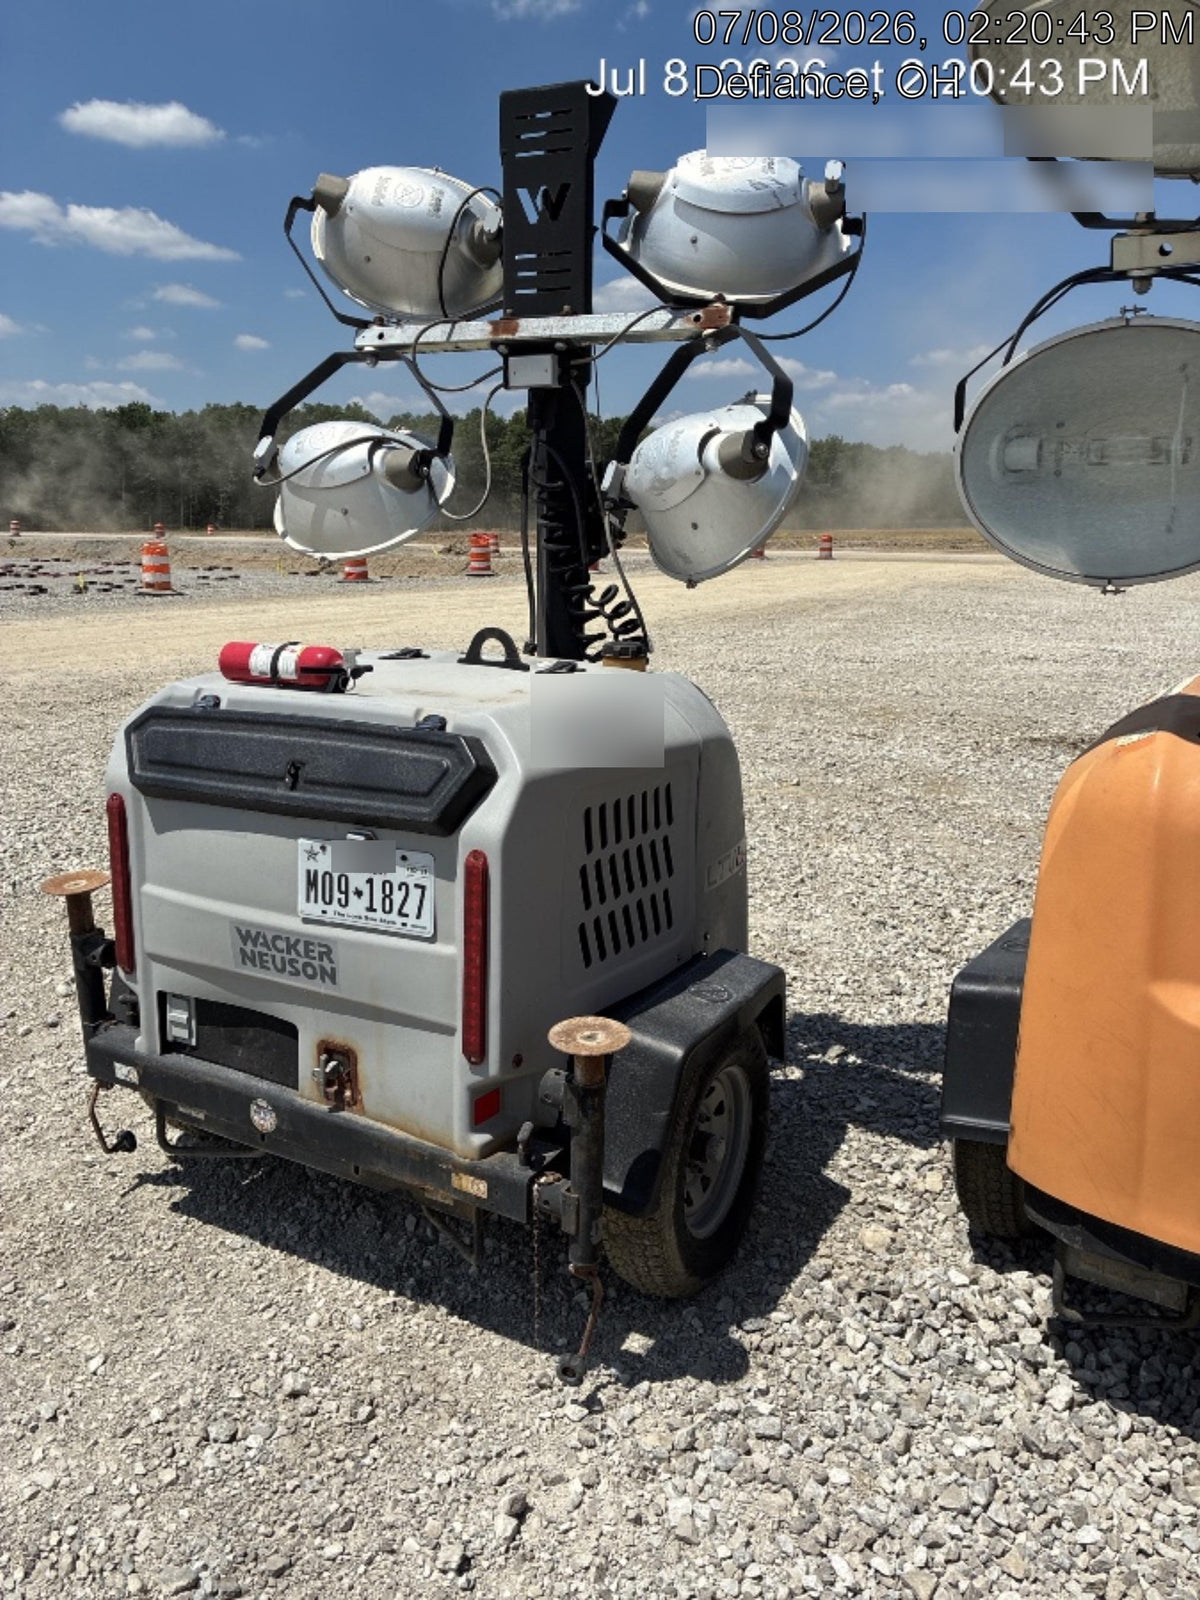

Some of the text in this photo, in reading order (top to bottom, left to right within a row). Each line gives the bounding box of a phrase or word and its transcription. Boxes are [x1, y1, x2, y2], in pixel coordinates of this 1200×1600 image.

[364, 877, 427, 920] 1827
[234, 926, 335, 964] WACKER
[240, 947, 337, 985] NEUSON
